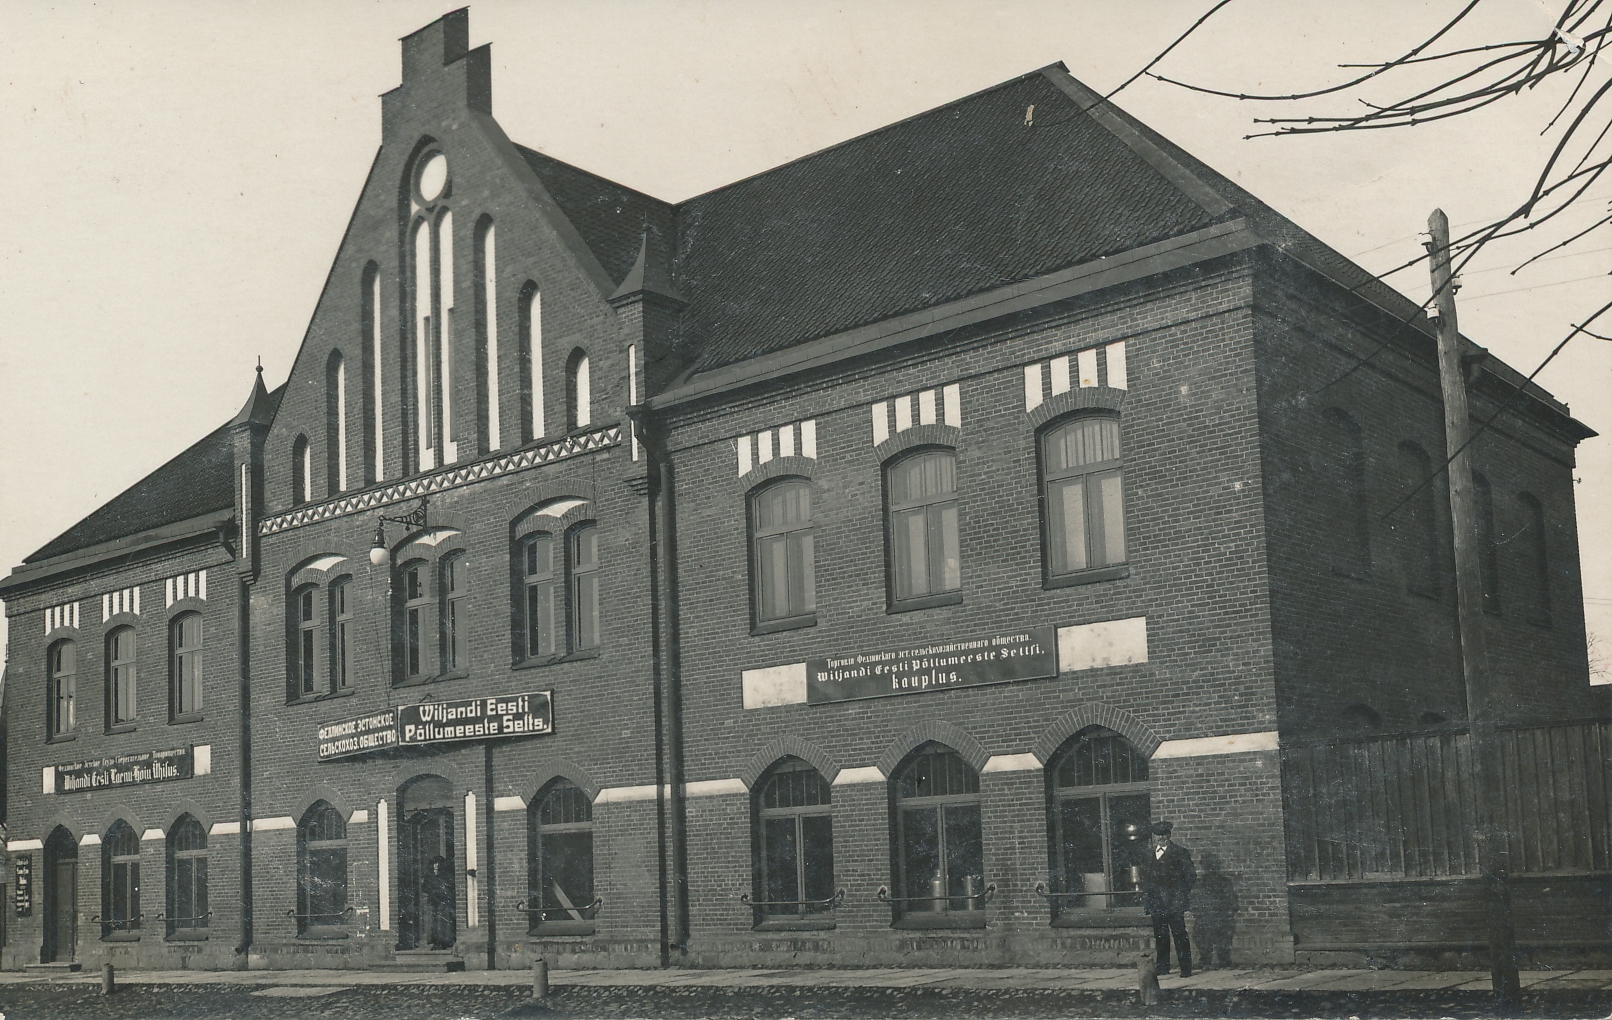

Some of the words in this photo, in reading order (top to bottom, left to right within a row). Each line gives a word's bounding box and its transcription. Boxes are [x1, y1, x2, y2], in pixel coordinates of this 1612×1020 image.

[817, 666, 870, 681] Wiljandi
[875, 660, 908, 675] Eesti
[892, 669, 962, 690] kauplus.
[419, 700, 481, 723] Wiljandi
[487, 696, 529, 715] Eesti
[319, 721, 356, 740] ФЕЛЛИНСКОЕ
[357, 713, 394, 733] ЭСТОНСКОЕ
[503, 713, 548, 733] Selts.
[360, 730, 396, 748] ОБЩЕСТВО
